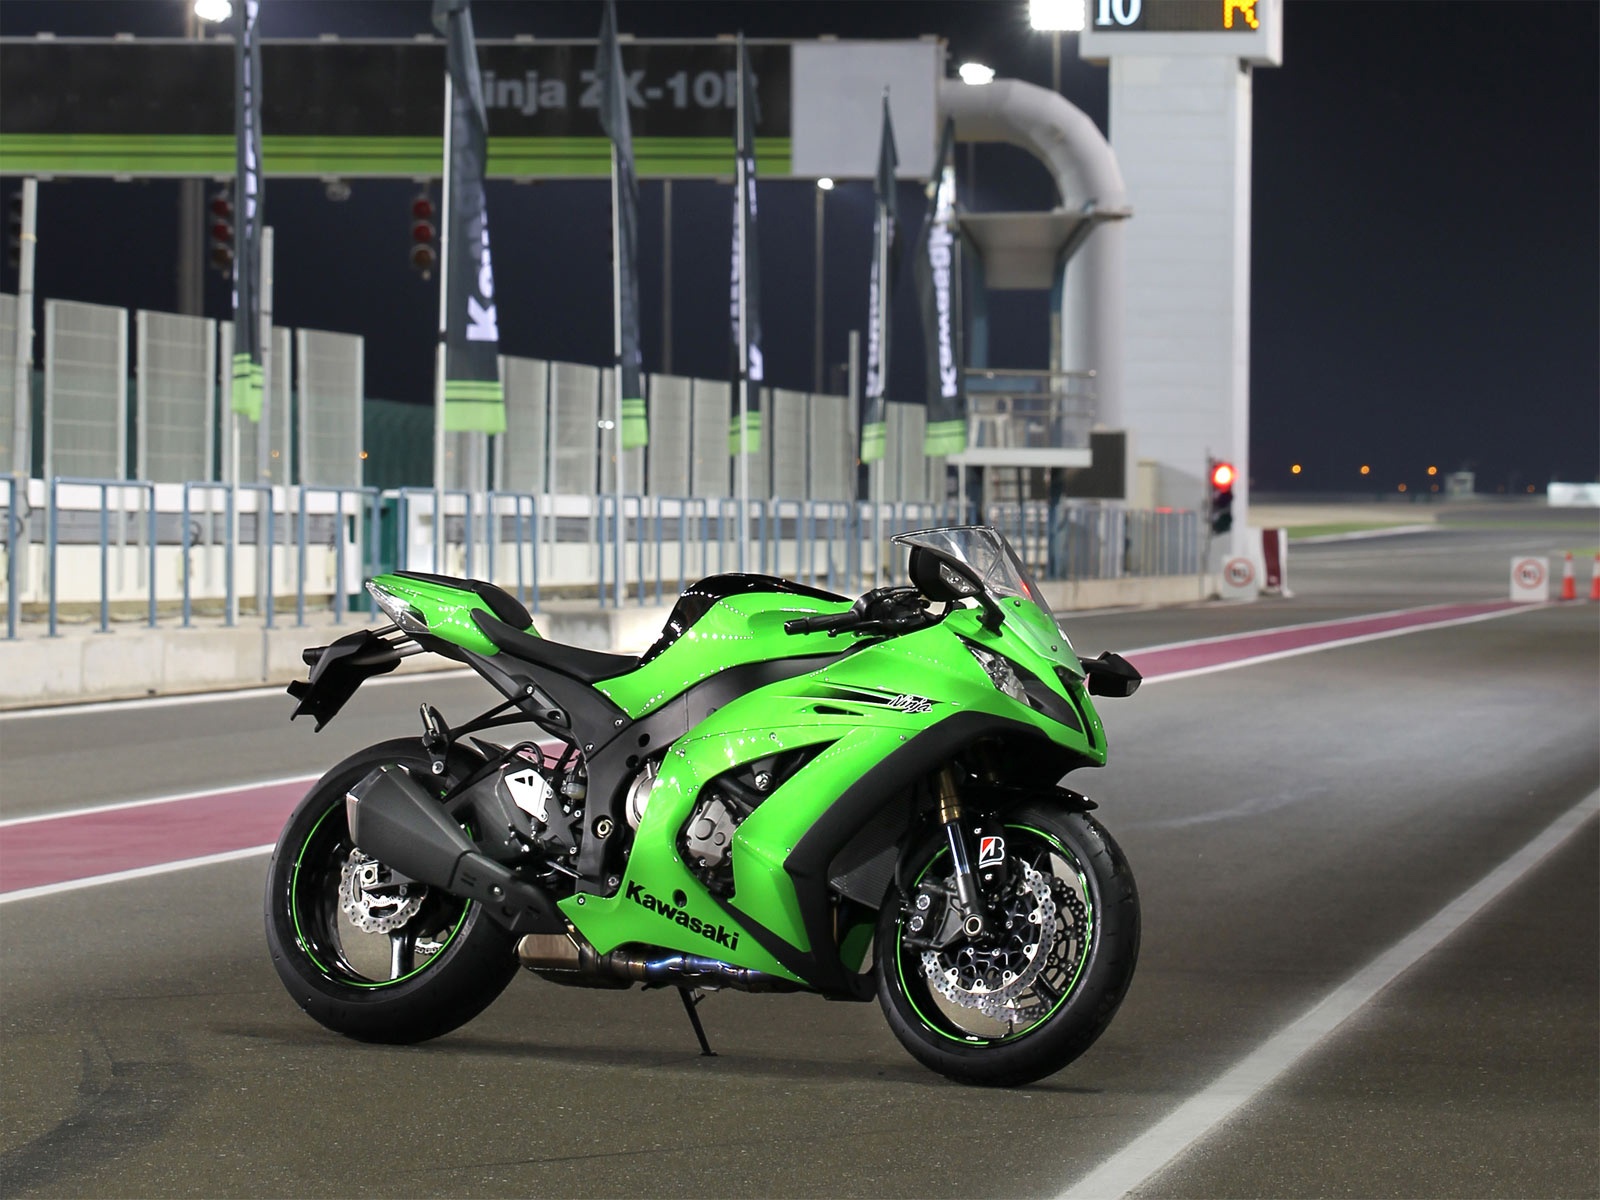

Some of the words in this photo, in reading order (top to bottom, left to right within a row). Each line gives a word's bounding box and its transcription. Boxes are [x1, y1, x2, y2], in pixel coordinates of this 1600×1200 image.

[483, 69, 567, 116] inja
[887, 694, 933, 714] Ninja
[625, 880, 740, 952] Kawasaki
